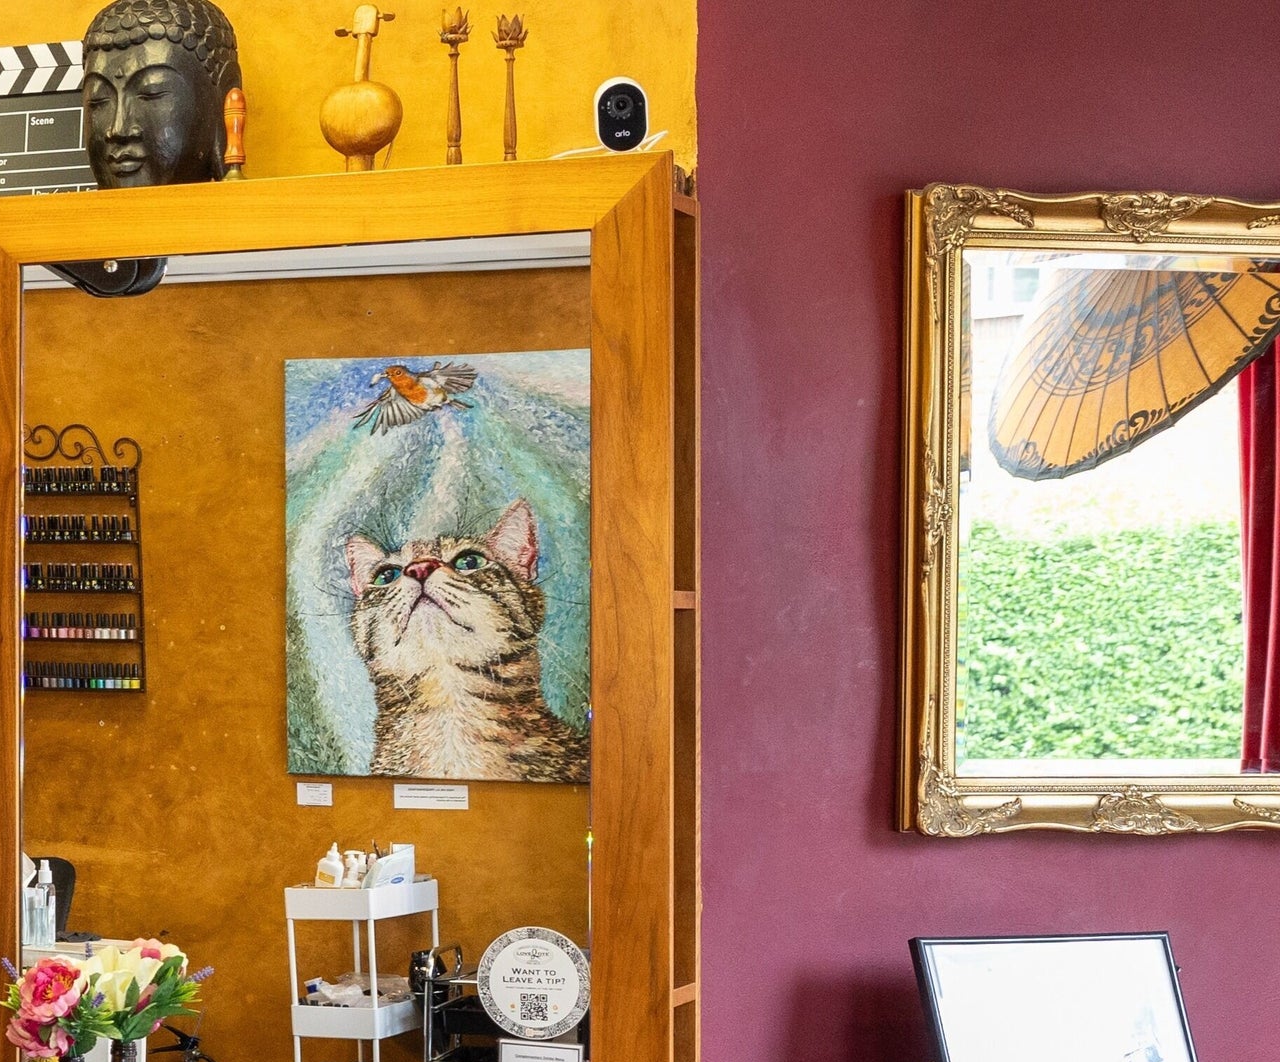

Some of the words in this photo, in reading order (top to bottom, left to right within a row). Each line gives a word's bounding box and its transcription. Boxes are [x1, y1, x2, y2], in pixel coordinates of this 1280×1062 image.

[30, 116, 55, 126] Scene
[614, 129, 631, 138] arlo
[511, 967, 541, 976] WANT
[543, 969, 557, 977] TO
[502, 975, 534, 984] LEAVE
[545, 977, 566, 985] TIP?
